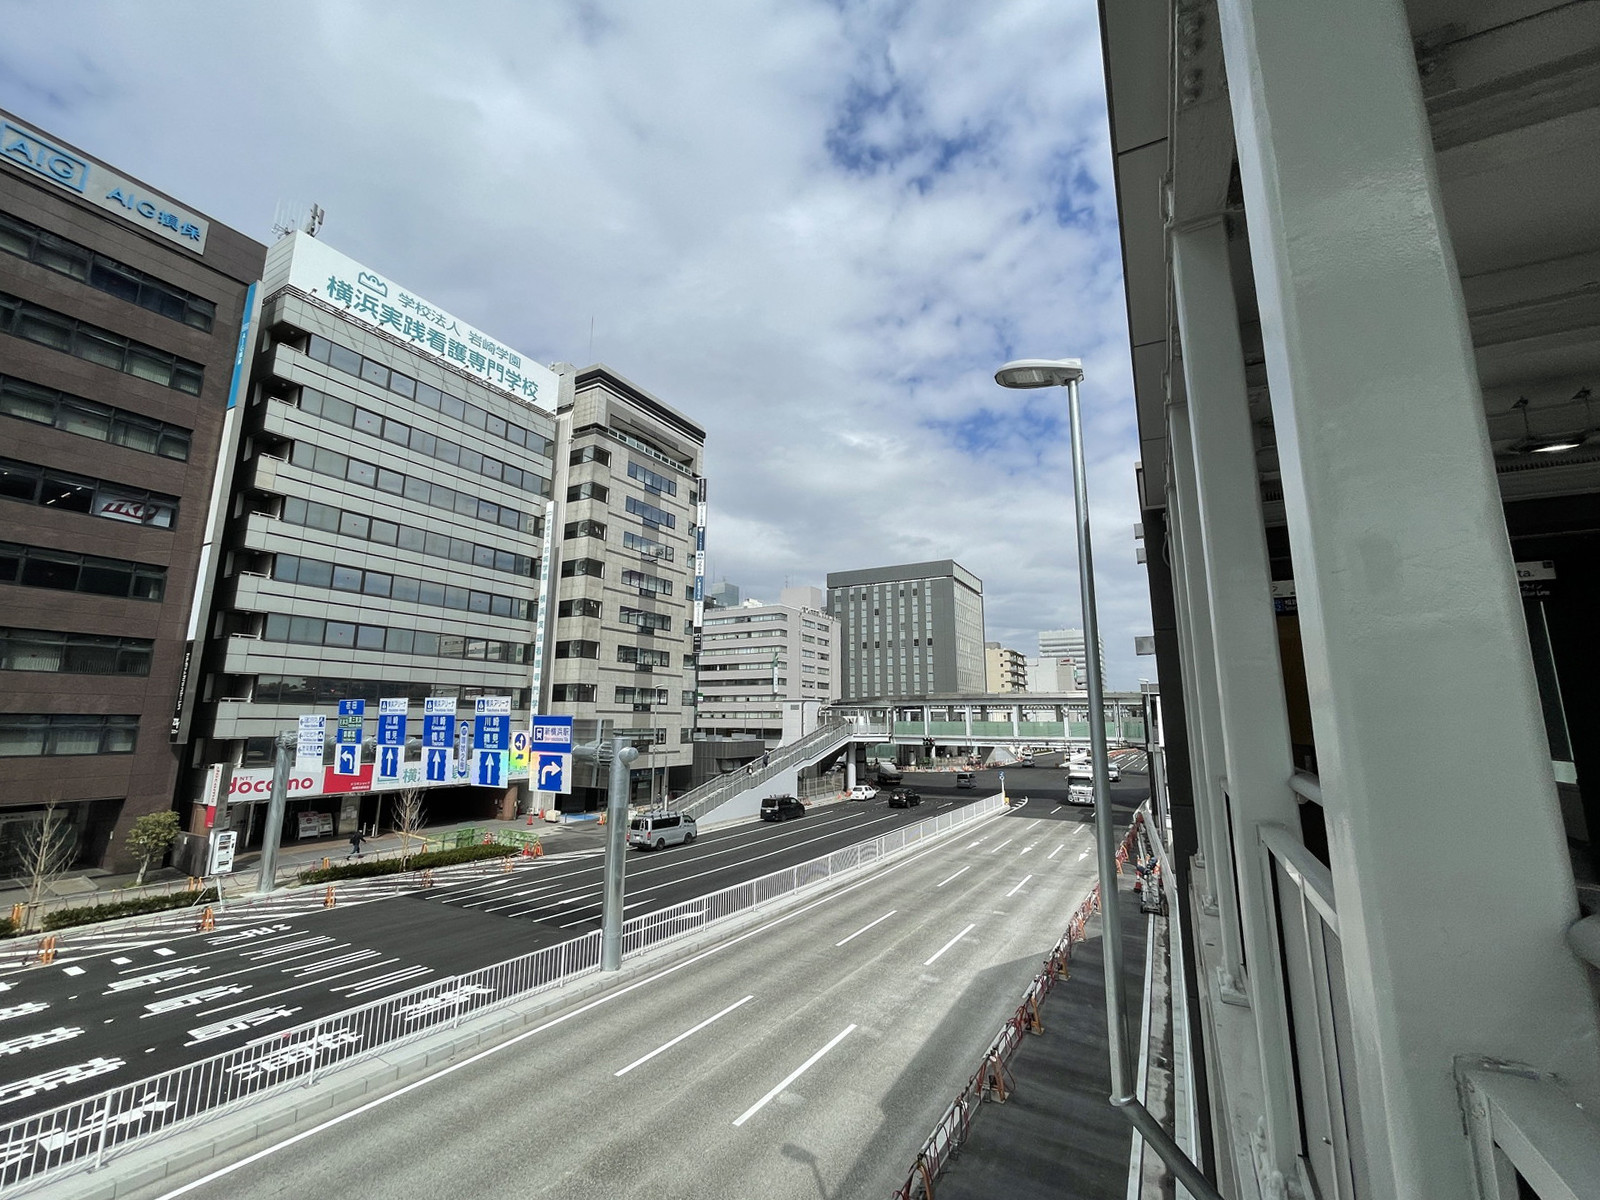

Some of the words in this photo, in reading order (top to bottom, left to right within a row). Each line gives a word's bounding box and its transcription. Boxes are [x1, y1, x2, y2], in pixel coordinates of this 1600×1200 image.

[6, 139, 74, 179] AIG
[106, 187, 200, 242] AIG損保
[326, 275, 539, 401] 横浜実践看護専門学校
[398, 292, 460, 337] 学校法人
[468, 330, 521, 369] 岩崎学園
[102, 501, 157, 518] TKP
[544, 727, 569, 736] 新横浜駅
